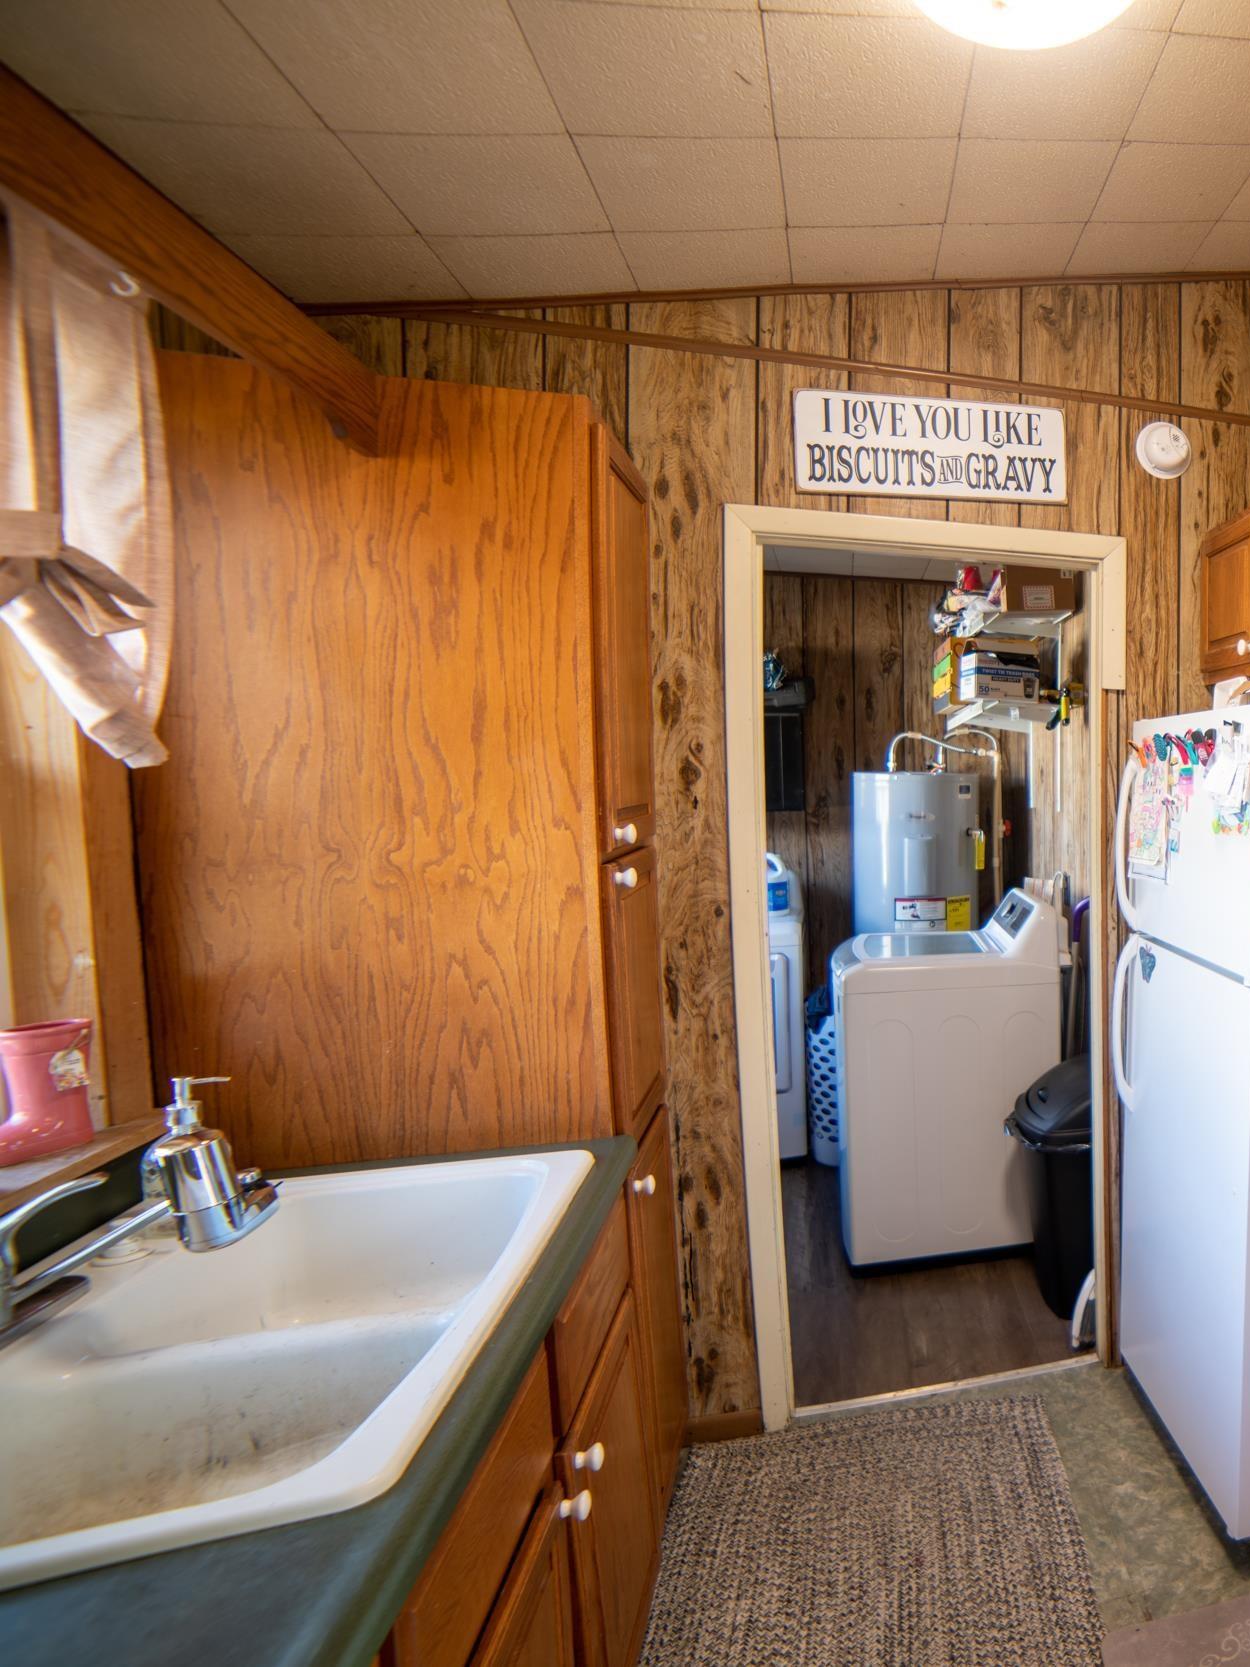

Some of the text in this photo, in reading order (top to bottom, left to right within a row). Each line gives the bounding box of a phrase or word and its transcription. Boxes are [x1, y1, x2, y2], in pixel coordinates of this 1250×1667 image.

[822, 397, 1042, 449] I LOVE YOU LIKE
[806, 443, 1057, 493] BISCUITS AND GRAVY
